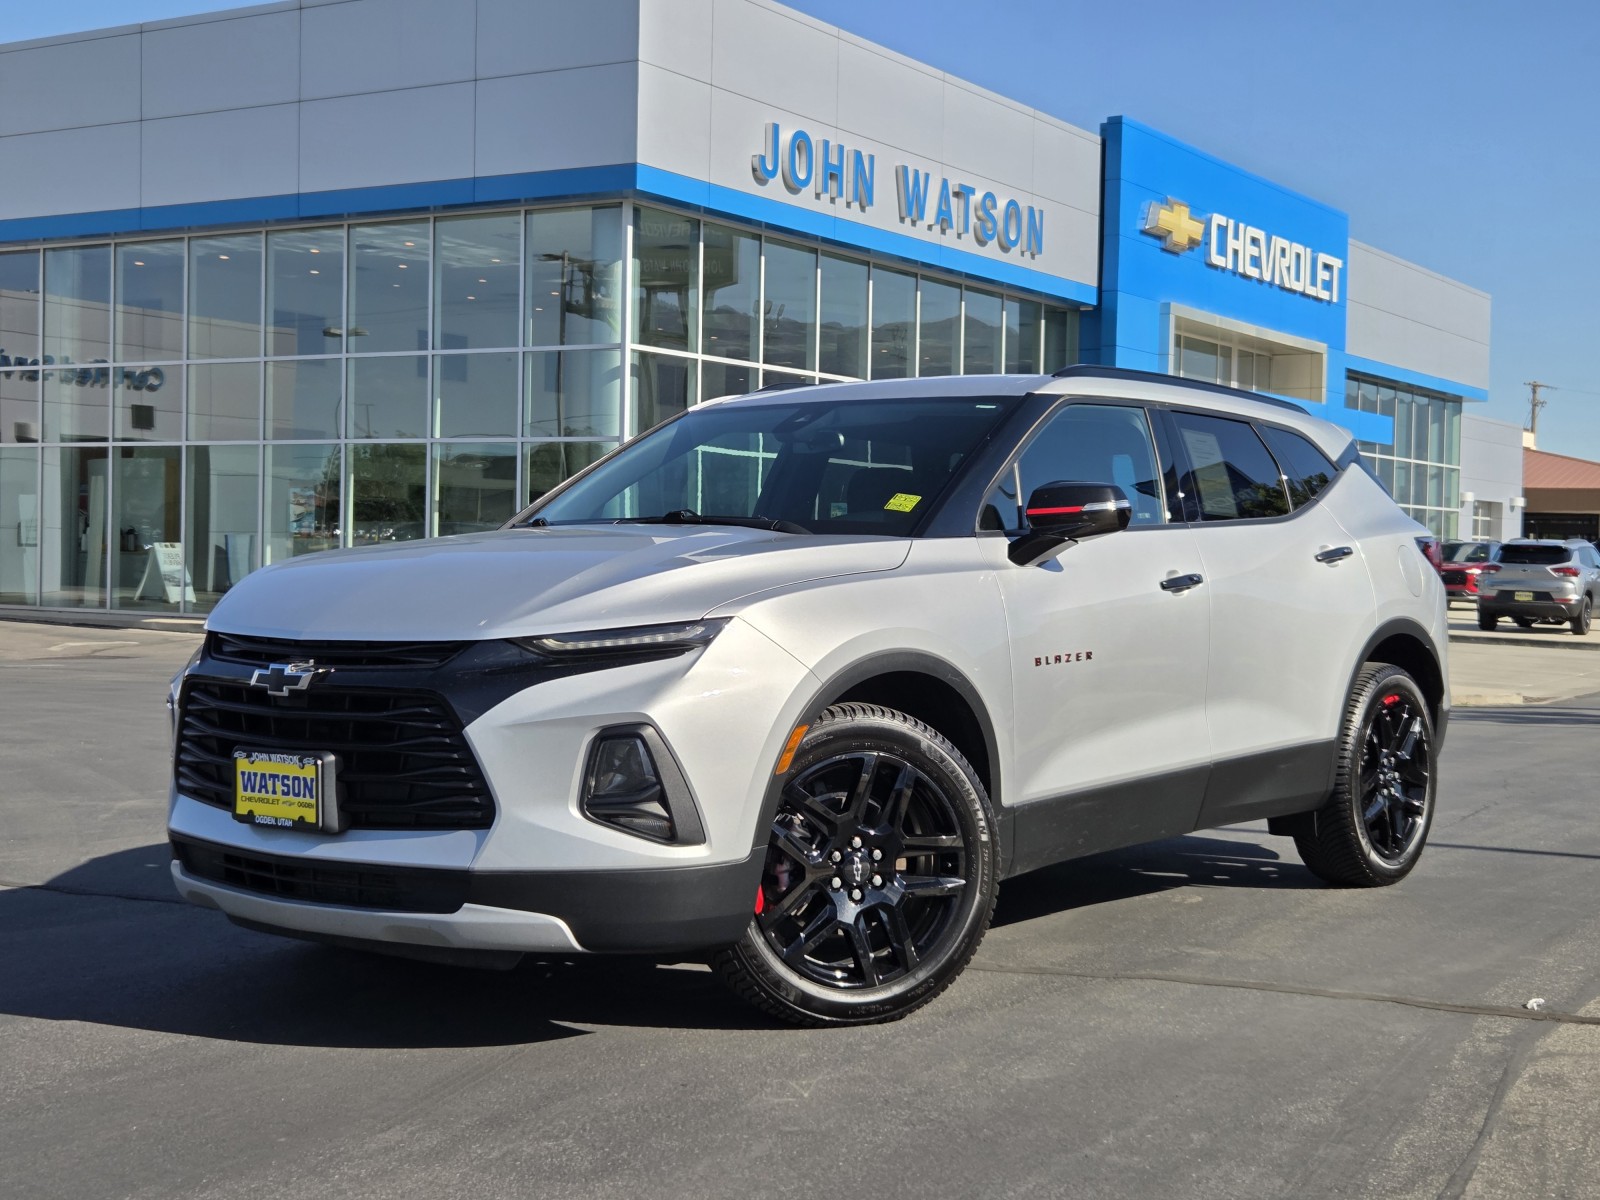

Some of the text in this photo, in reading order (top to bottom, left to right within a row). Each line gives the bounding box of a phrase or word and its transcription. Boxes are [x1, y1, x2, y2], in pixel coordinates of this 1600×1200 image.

[752, 122, 1044, 256] JOHN WATSON
[1207, 213, 1343, 303] CHEVROLET
[1034, 651, 1093, 667] BLAZER
[251, 752, 300, 765] JOHN WATSON
[240, 771, 315, 799] WATSON
[240, 796, 315, 809] CHEVROLET OGDEN
[277, 819, 293, 827] UTAH
